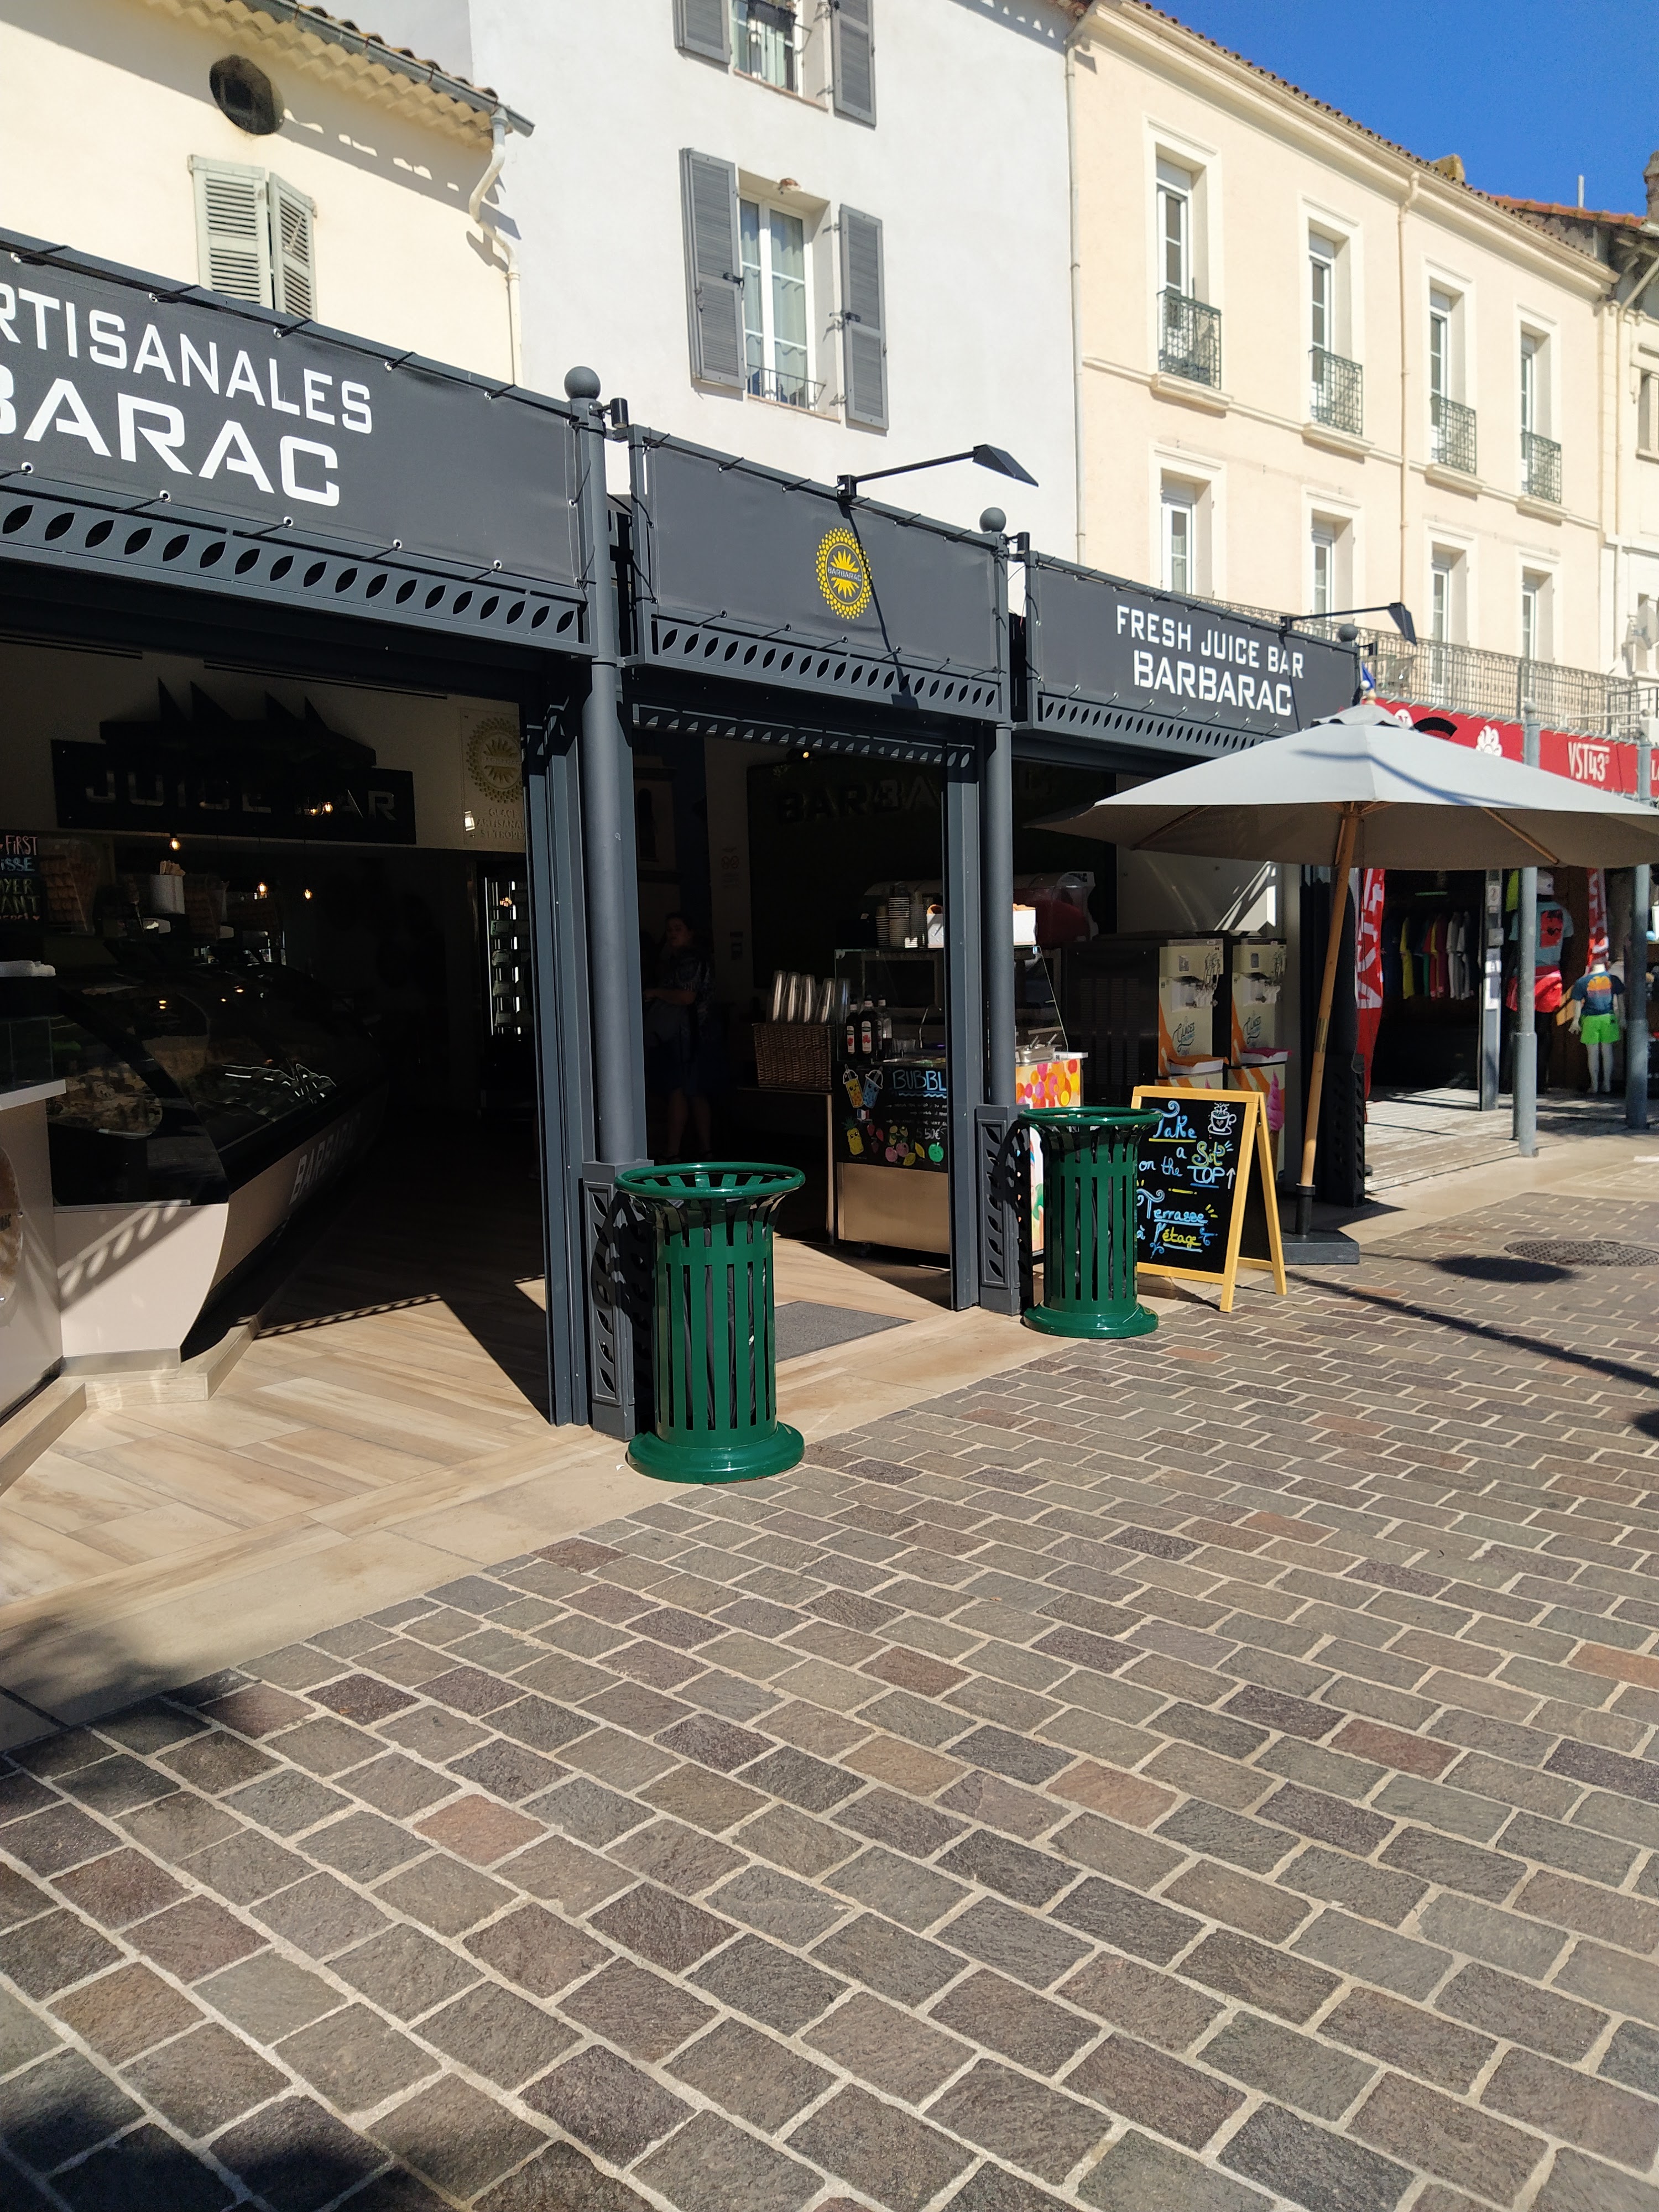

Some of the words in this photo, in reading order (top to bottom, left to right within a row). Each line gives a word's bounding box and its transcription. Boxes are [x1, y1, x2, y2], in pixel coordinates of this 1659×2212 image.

[0, 364, 340, 507] ARAC
[827, 567, 862, 582] BARBARAC
[1117, 605, 1192, 652] FRESH
[1201, 629, 1260, 668] JUICE
[1267, 646, 1304, 679] BAR
[1134, 650, 1292, 716] BARBARAC
[1139, 1161, 1156, 1171] on
[1161, 1156, 1183, 1177] the
[1187, 1165, 1225, 1183] TOP
[1176, 1146, 1187, 1159] a
[1136, 1188, 1209, 1223] Terrasse
